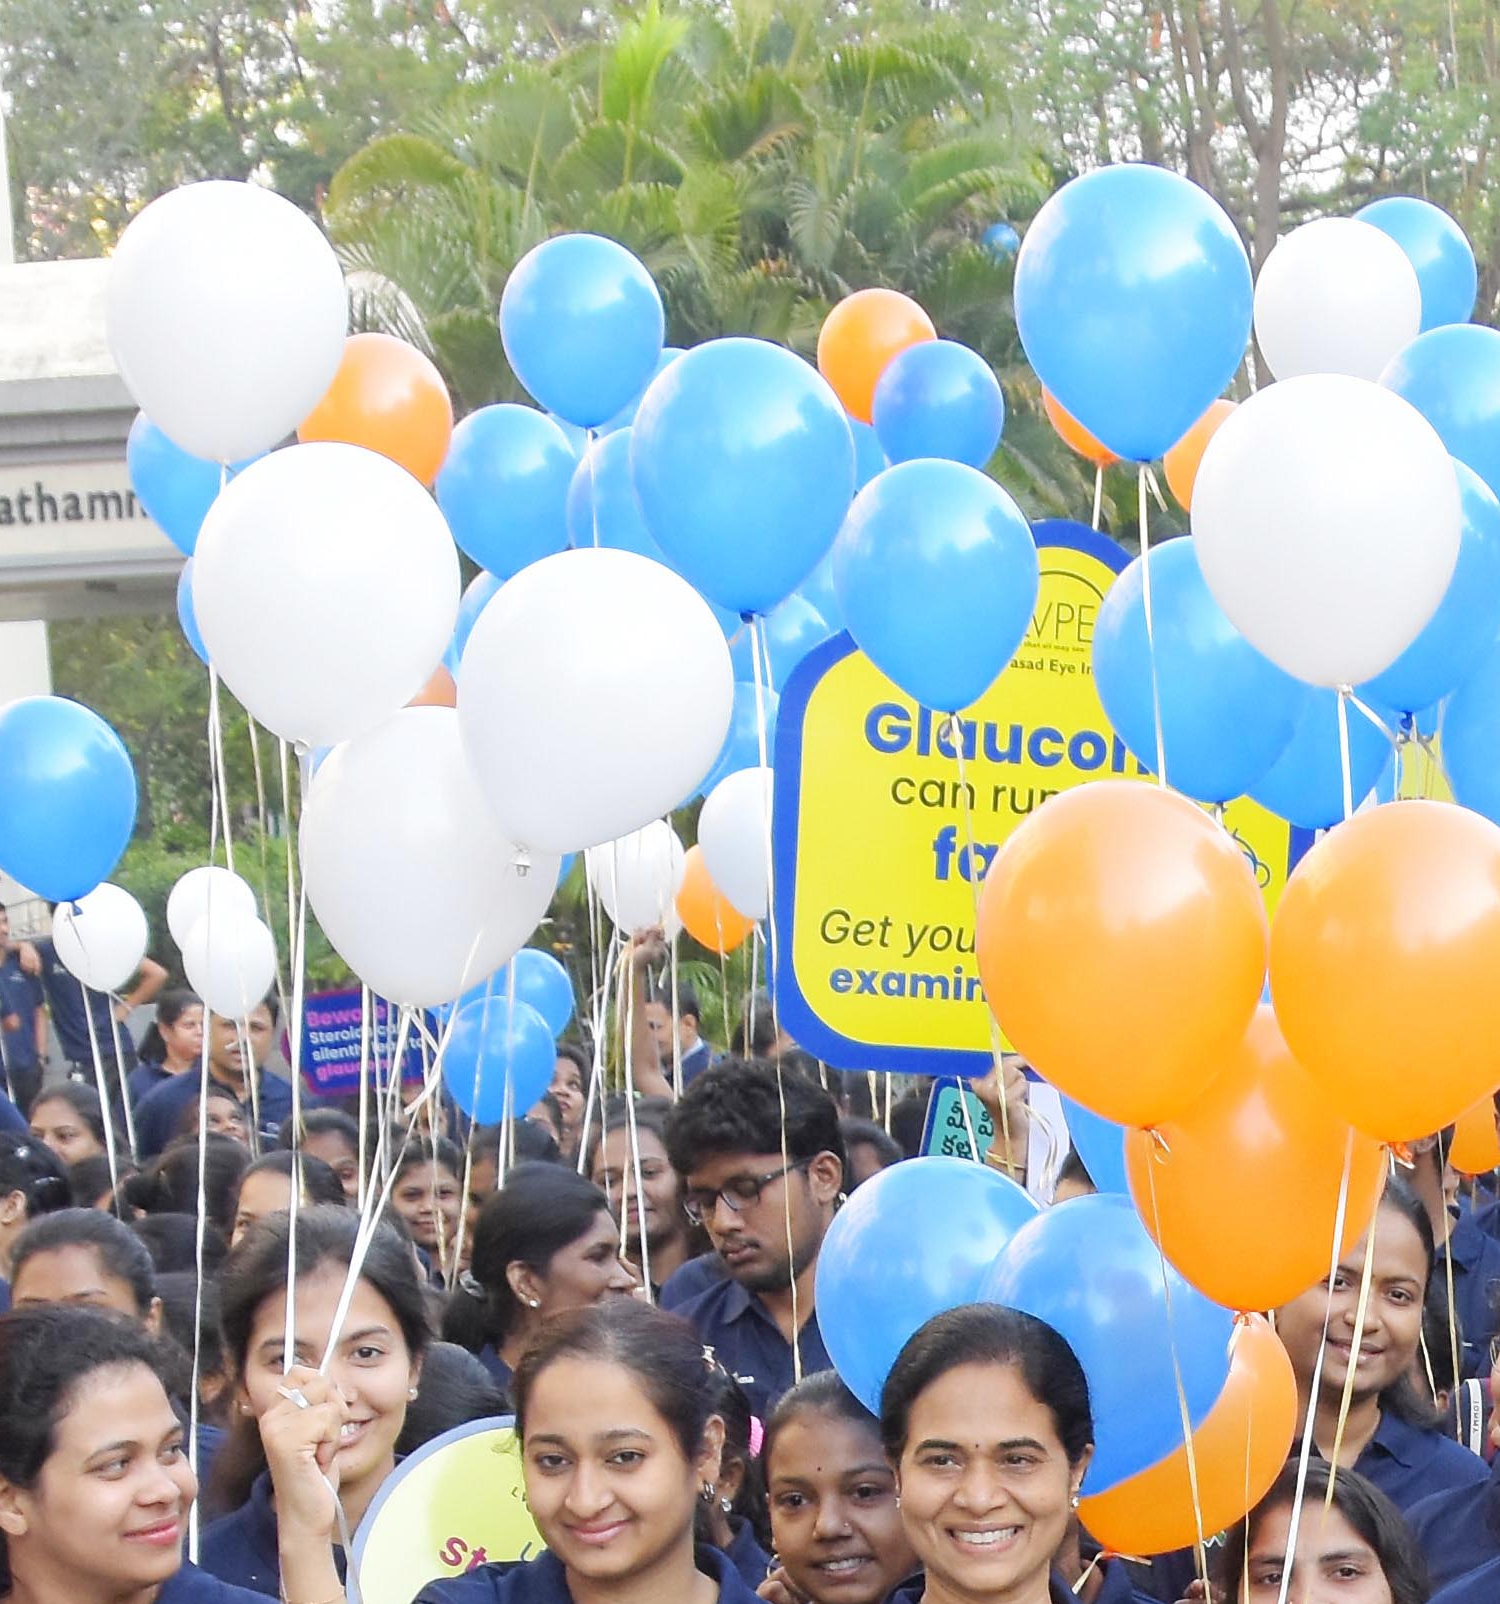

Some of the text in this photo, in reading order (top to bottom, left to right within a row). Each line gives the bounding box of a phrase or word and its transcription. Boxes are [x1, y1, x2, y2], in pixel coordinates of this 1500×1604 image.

[1010, 658, 1075, 675] asad Eye
[864, 702, 1149, 774] Glauco
[891, 777, 975, 810] can
[820, 909, 891, 947] Get
[829, 966, 987, 1002] examin
